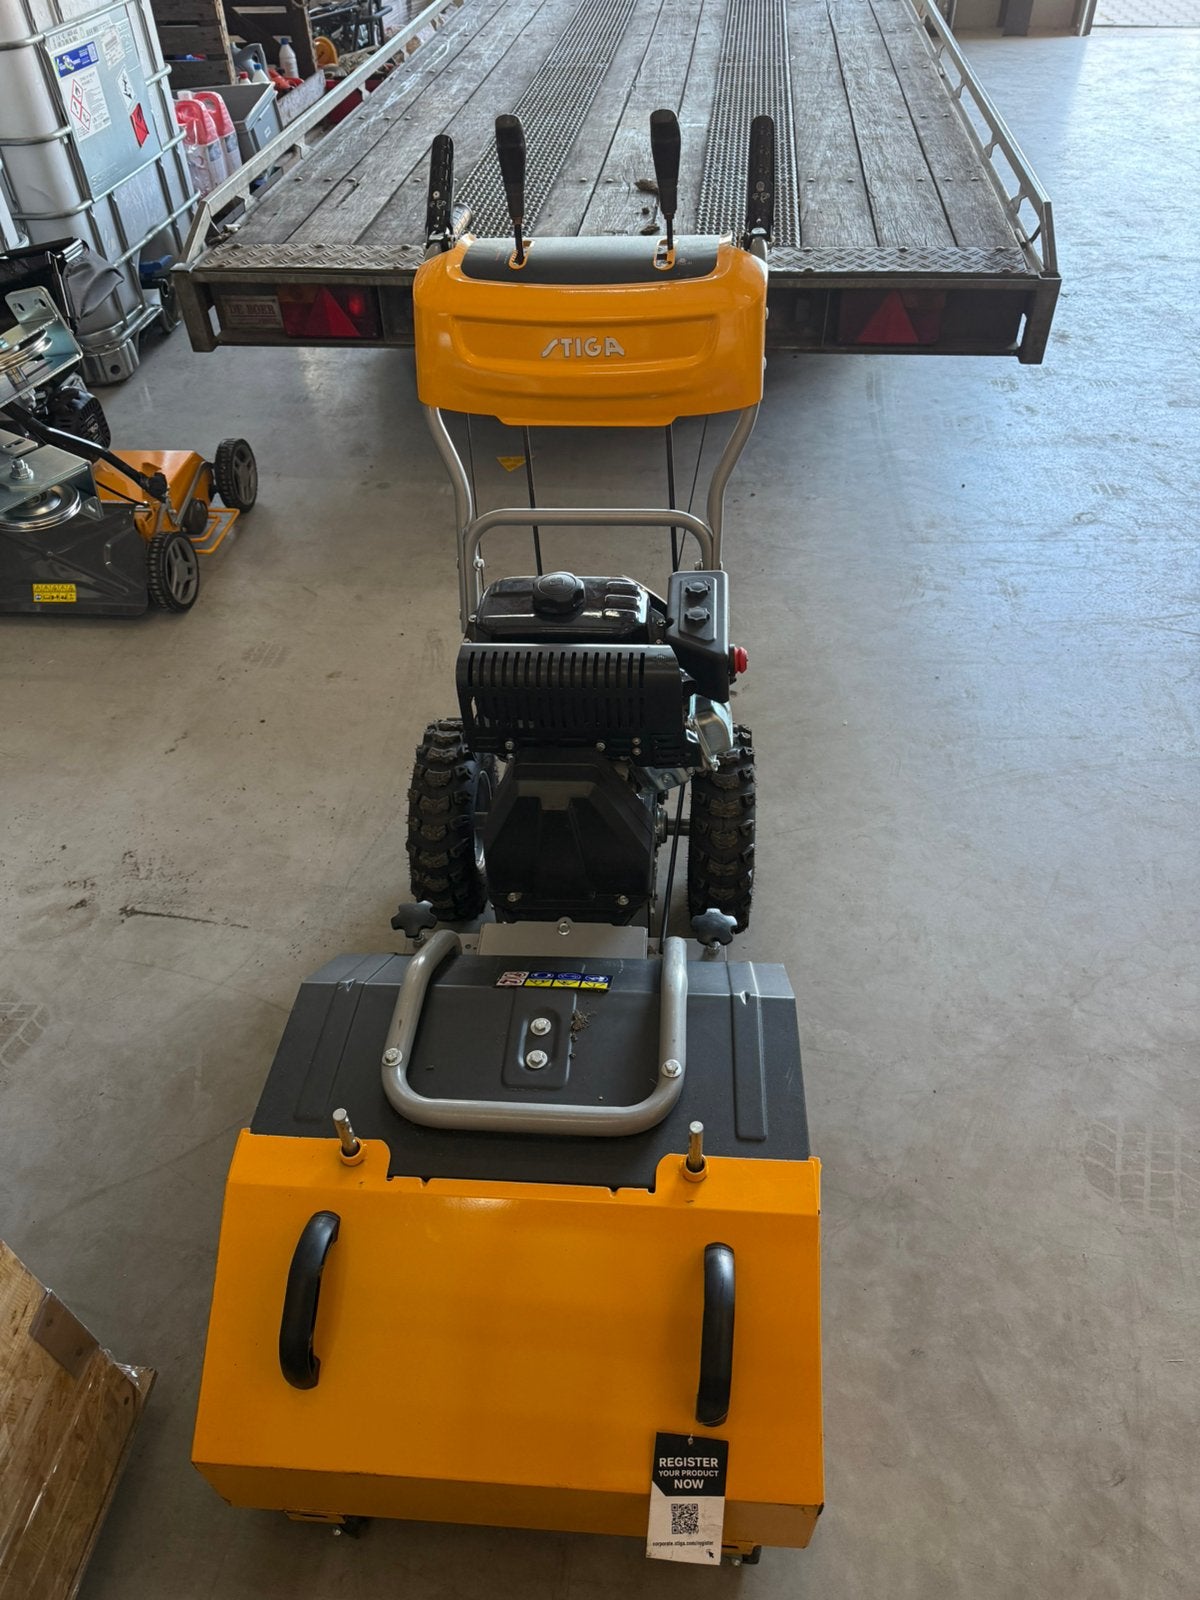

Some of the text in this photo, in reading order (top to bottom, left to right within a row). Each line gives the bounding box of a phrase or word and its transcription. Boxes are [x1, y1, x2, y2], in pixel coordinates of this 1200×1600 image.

[541, 336, 625, 358] STIGA
[659, 1457, 718, 1468] REGISTER
[674, 1479, 704, 1489] NOW
